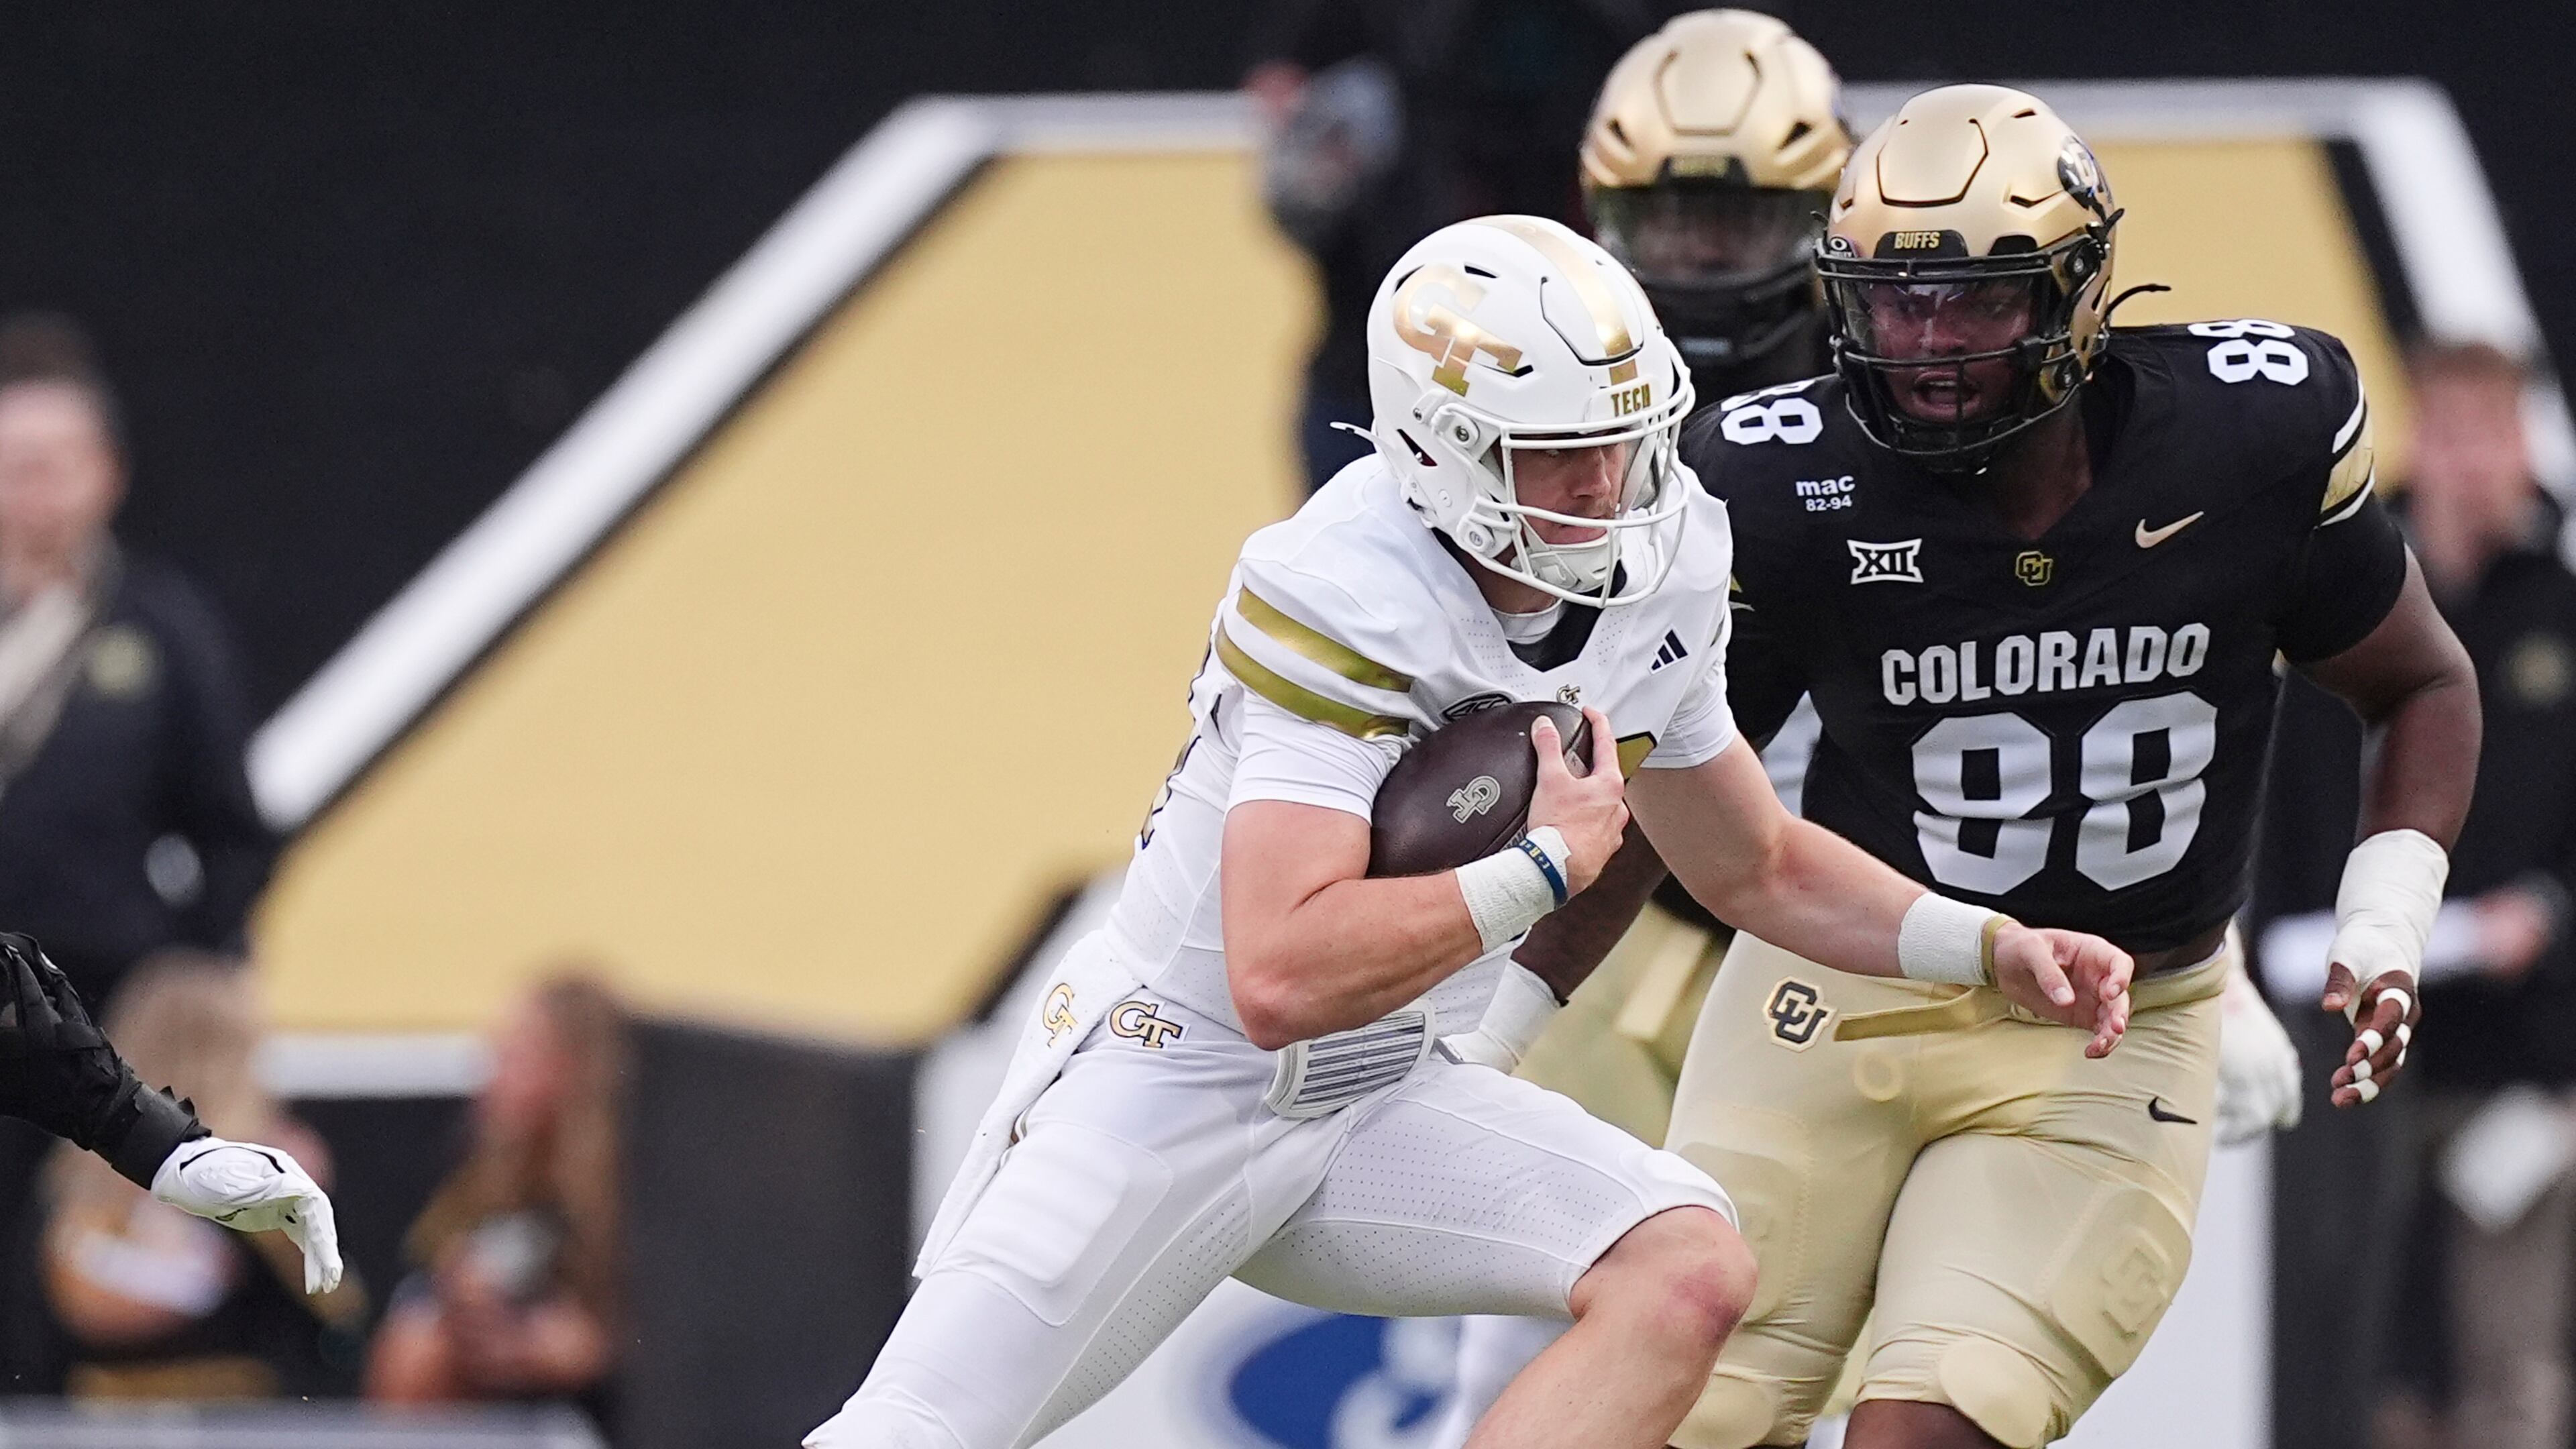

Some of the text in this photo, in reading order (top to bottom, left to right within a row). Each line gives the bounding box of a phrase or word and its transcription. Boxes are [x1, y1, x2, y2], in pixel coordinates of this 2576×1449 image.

[1894, 231, 1941, 250] BUFFS
[1393, 263, 1523, 397] GT
[2188, 319, 2309, 386] 88
[1611, 383, 1651, 417] TECH
[1795, 475, 1856, 496] mac
[1805, 494, 1853, 512] 82-94
[1851, 541, 1920, 582] XII
[2015, 550, 2053, 587] CU
[1881, 623, 2210, 706] COLORADO
[1912, 691, 2218, 896] 88
[1042, 982, 1078, 1049] GT
[1110, 1000, 1183, 1049] GT
[1766, 978, 1834, 1048] CU
